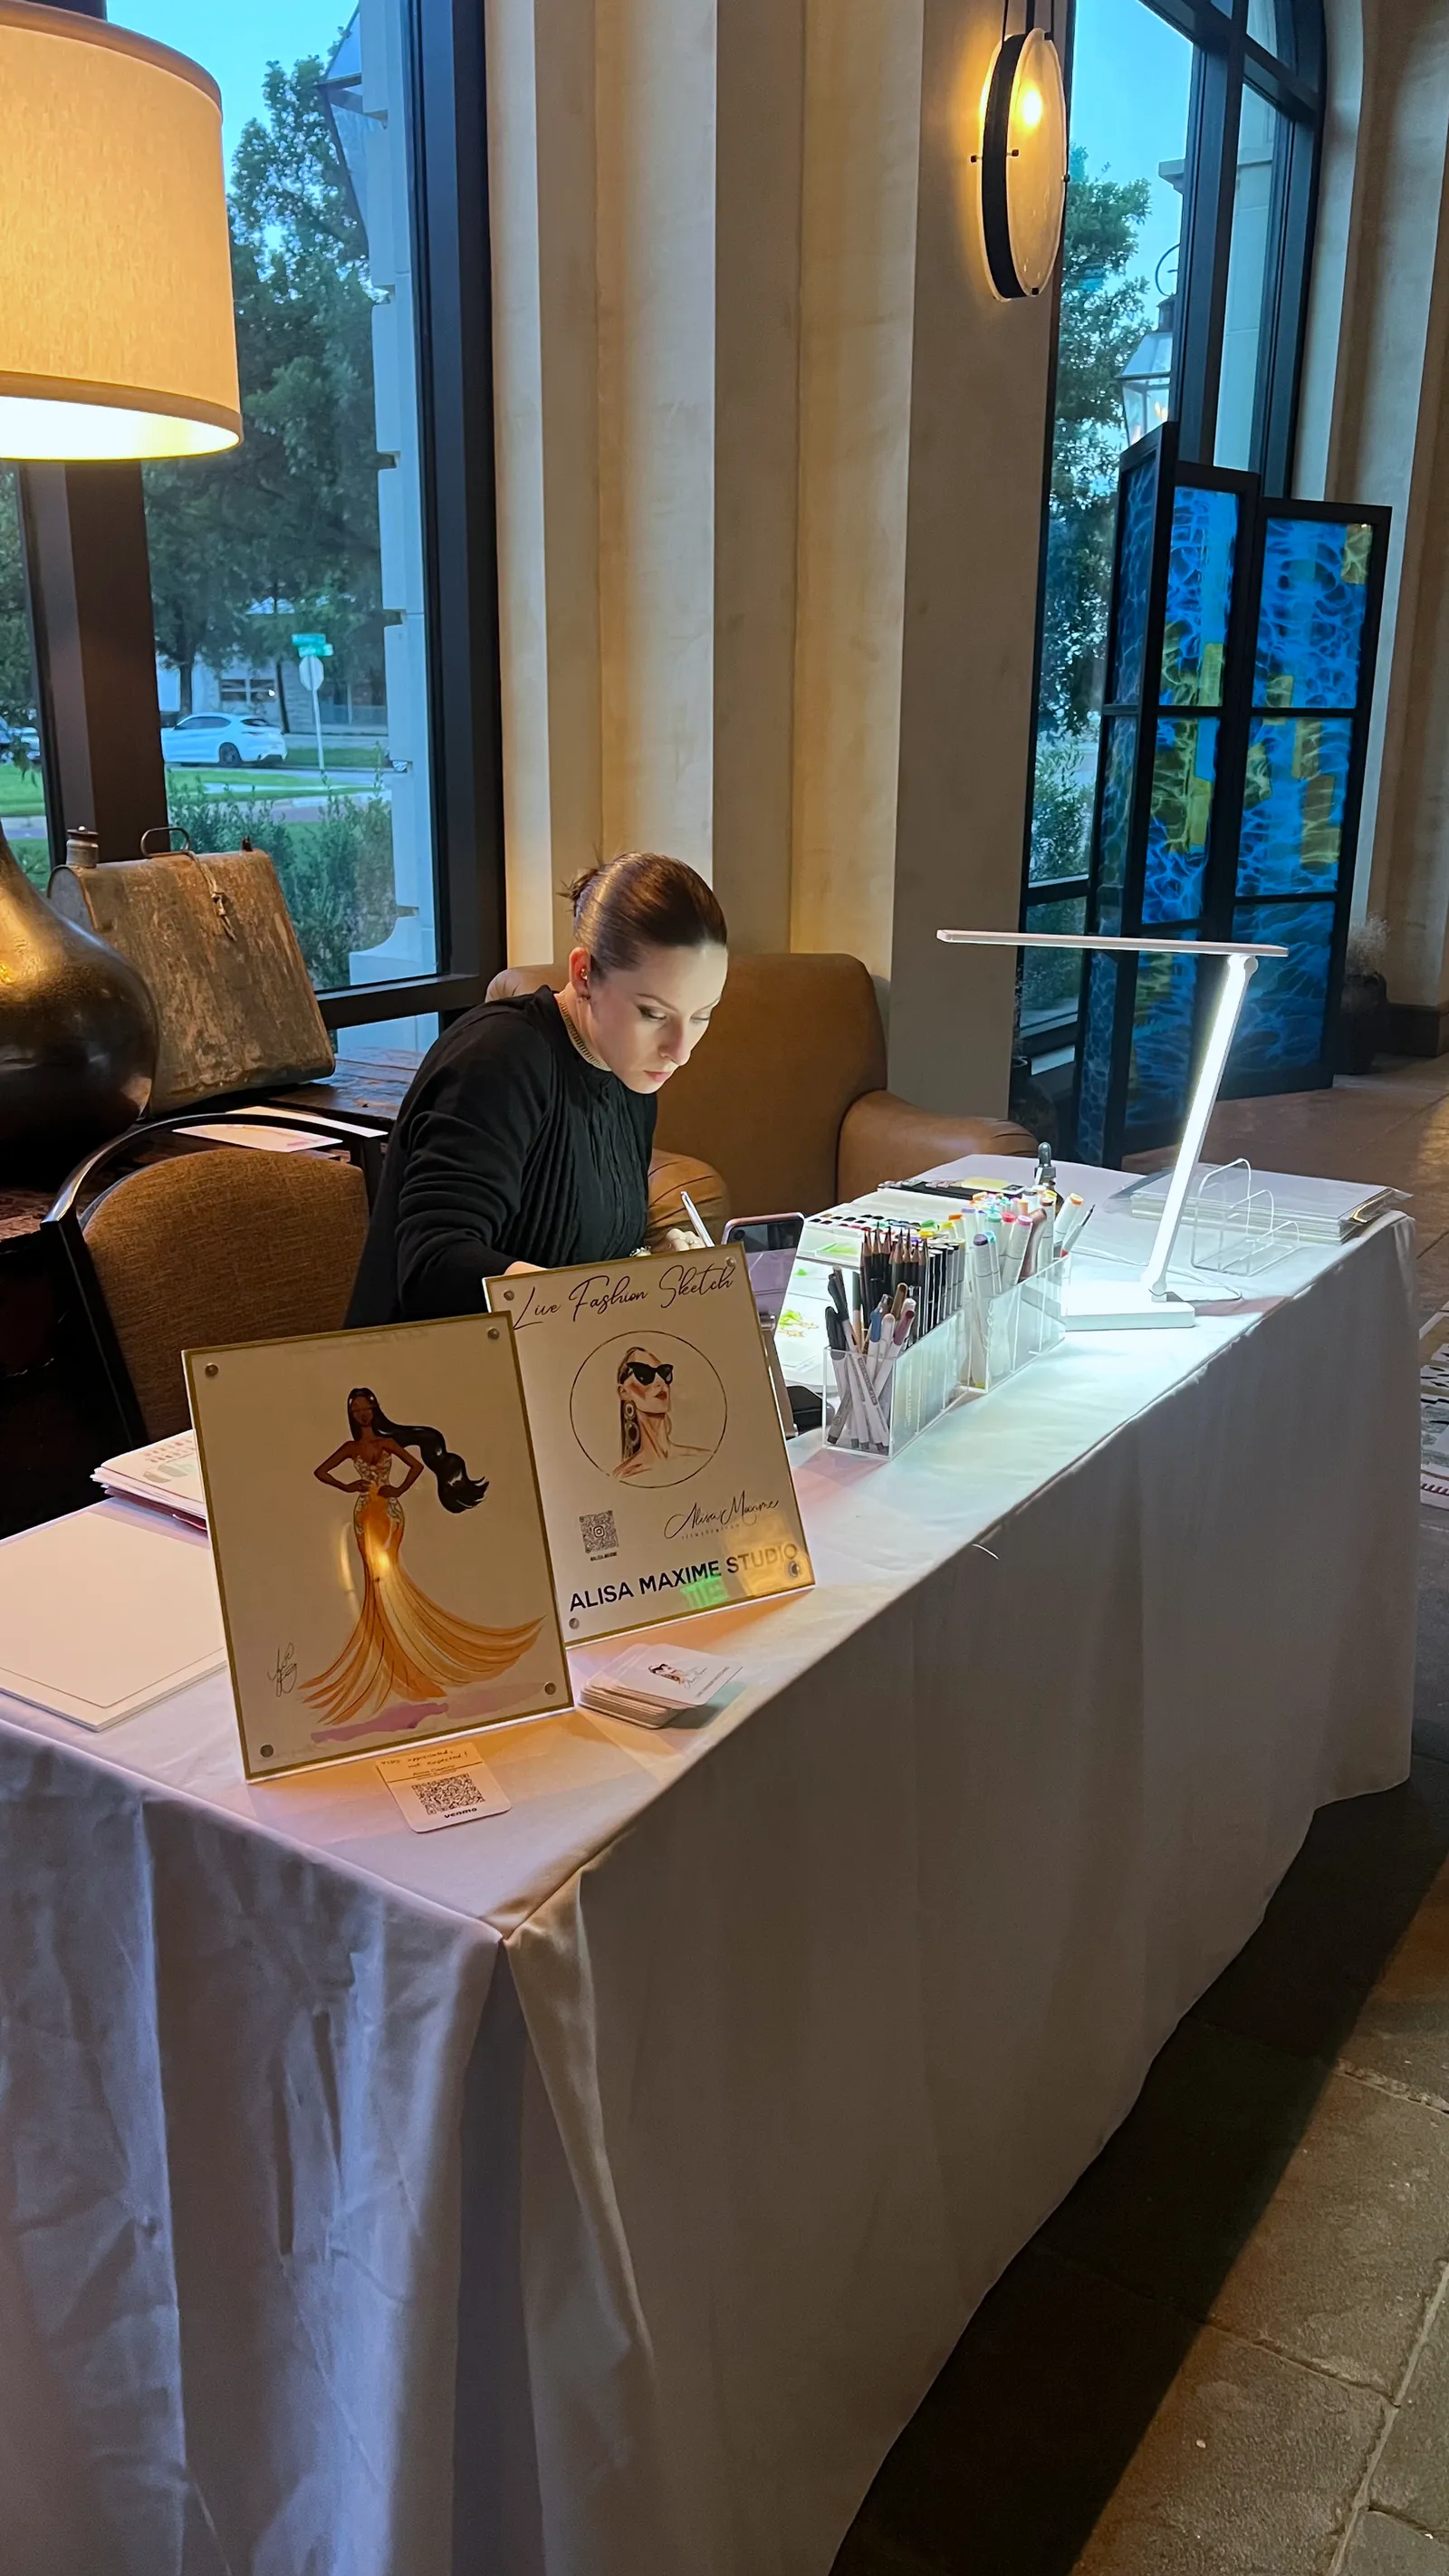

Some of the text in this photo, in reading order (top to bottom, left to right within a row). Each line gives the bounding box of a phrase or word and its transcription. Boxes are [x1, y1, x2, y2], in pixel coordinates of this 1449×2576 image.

[513, 1262, 736, 1331] Live Fashion Sketch
[569, 1543, 798, 1611] ALISA MAXIME STUDIO
[444, 1806, 477, 1819] venmo
